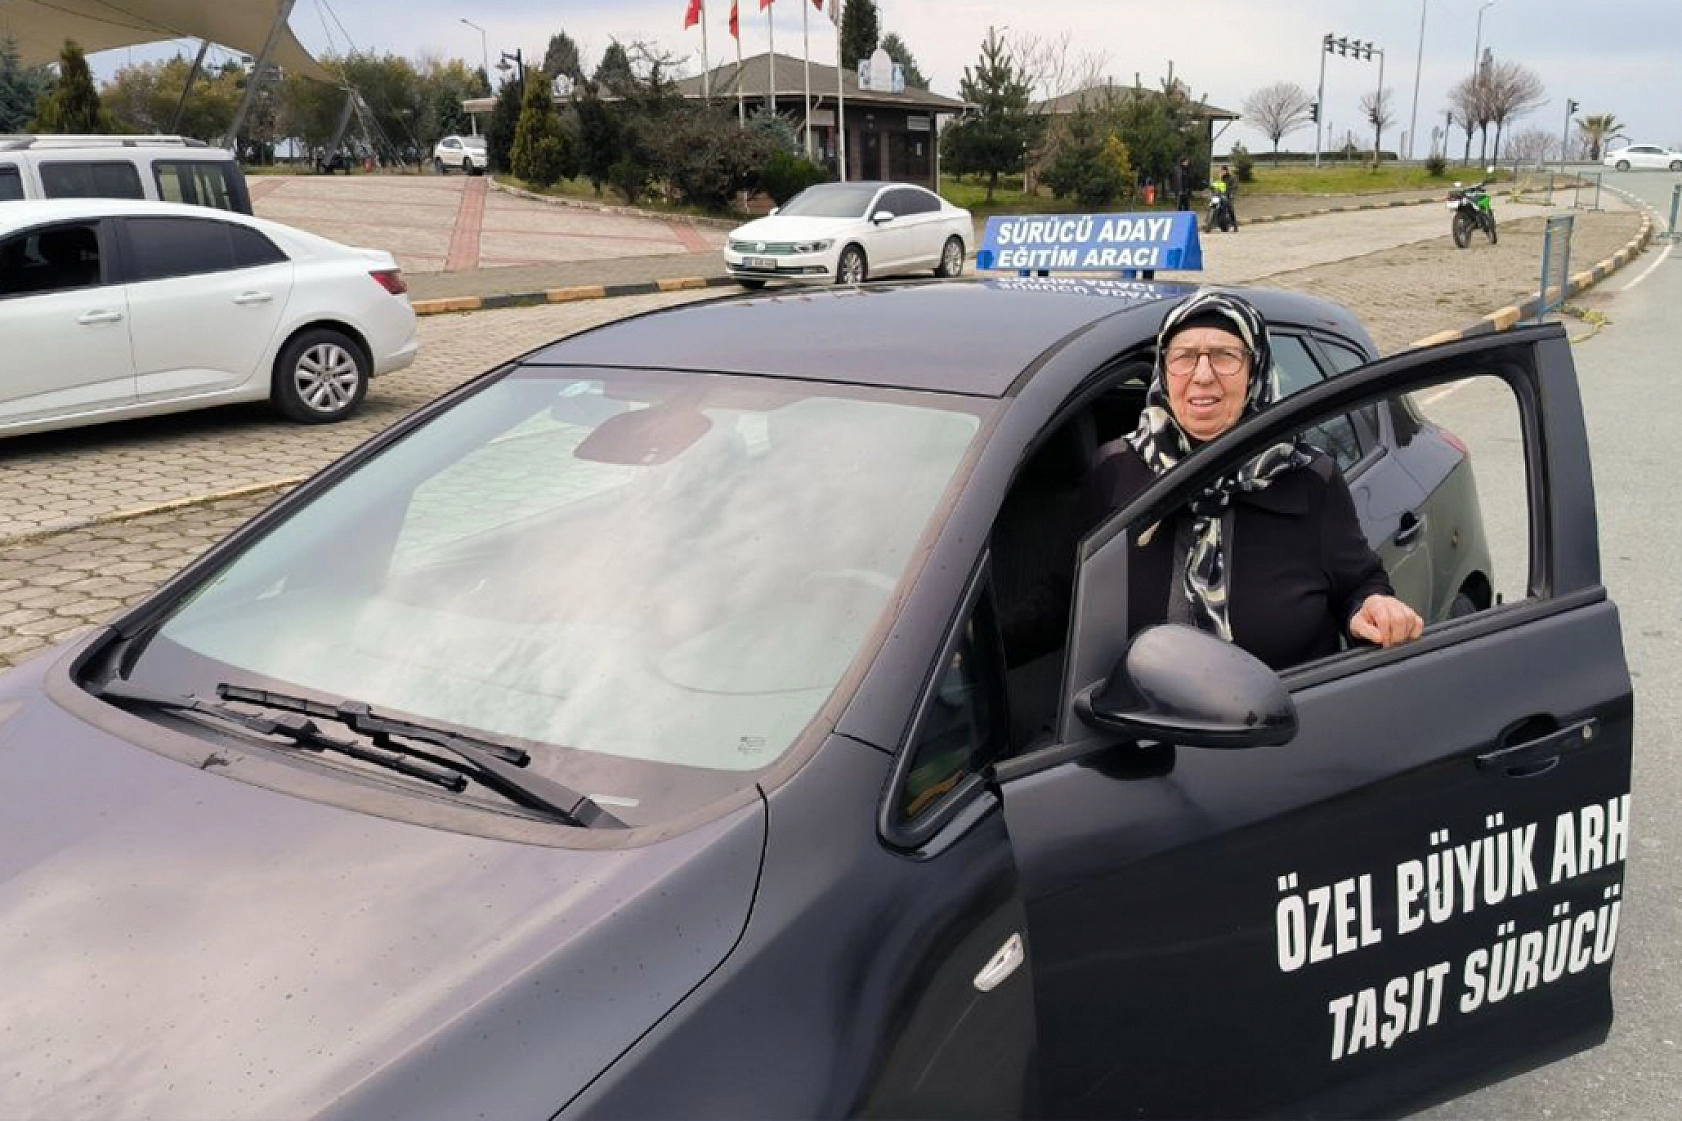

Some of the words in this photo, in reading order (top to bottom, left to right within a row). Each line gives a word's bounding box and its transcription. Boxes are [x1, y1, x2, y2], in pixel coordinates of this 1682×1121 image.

[997, 216, 1094, 245] SÜRÜCÜ
[1097, 218, 1173, 243] ADAYI
[1082, 247, 1159, 266] ARACI
[1276, 871, 1382, 973] ÖZEL
[1396, 811, 1538, 935] BÜYÜK
[1328, 961, 1450, 1061] TAŞIT
[1459, 883, 1621, 1014] SÜRÜCÜ
